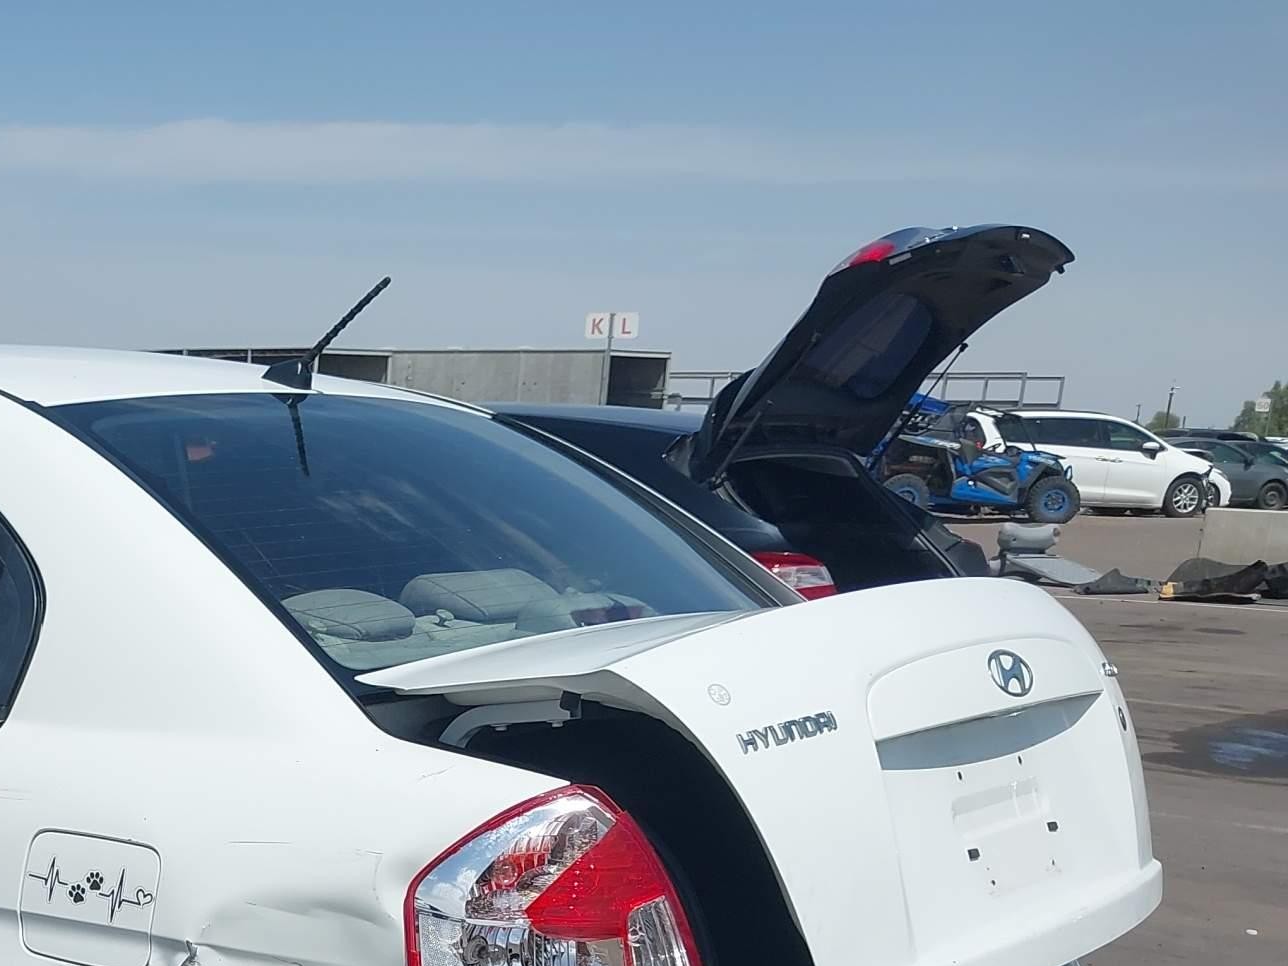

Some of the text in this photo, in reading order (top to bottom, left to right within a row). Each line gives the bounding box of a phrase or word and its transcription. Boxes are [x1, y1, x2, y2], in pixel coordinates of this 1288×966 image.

[591, 317, 604, 335] K
[621, 317, 632, 335] L
[736, 711, 838, 755] HYUNDAI
